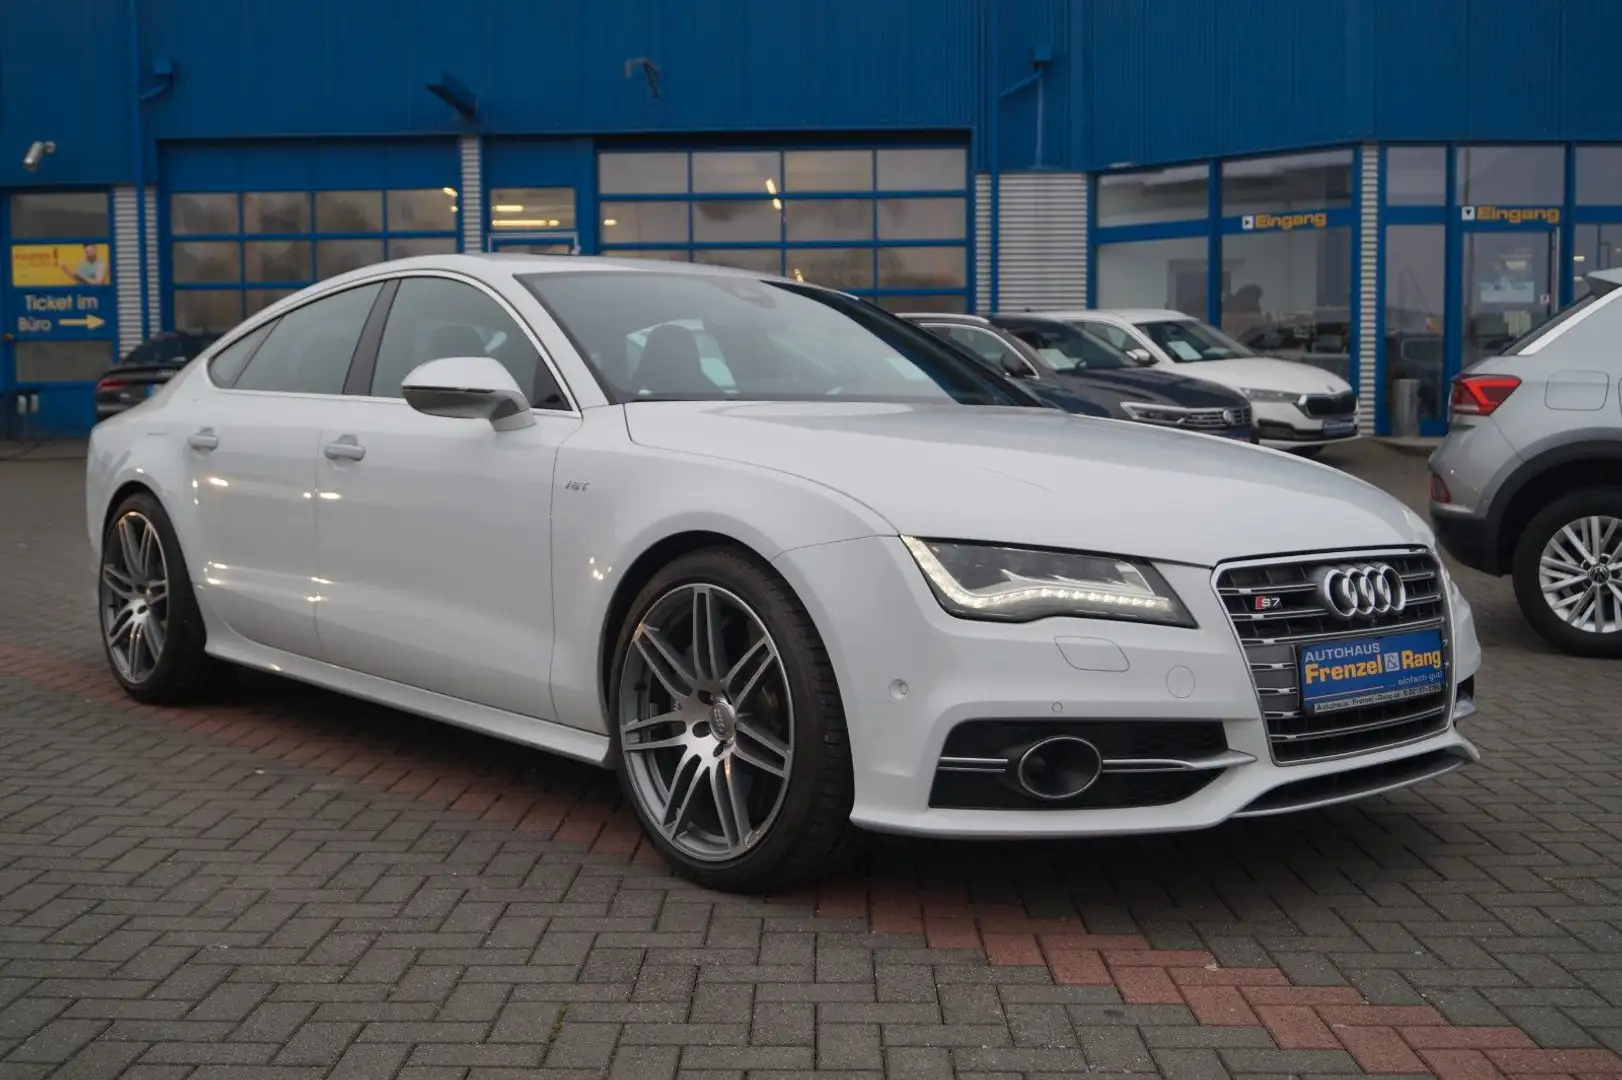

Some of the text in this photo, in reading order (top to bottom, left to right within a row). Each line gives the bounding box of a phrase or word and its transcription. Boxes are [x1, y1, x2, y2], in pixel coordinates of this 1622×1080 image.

[1255, 213, 1327, 230] Eingang
[1477, 205, 1560, 224] Eingang
[25, 294, 99, 311] Ticket im
[18, 316, 52, 332] Büro
[1260, 597, 1281, 608] S7
[1304, 643, 1380, 662] AUTOHAUS
[1304, 650, 1441, 684] Frenzel & Rang
[1397, 673, 1427, 686] einfach
